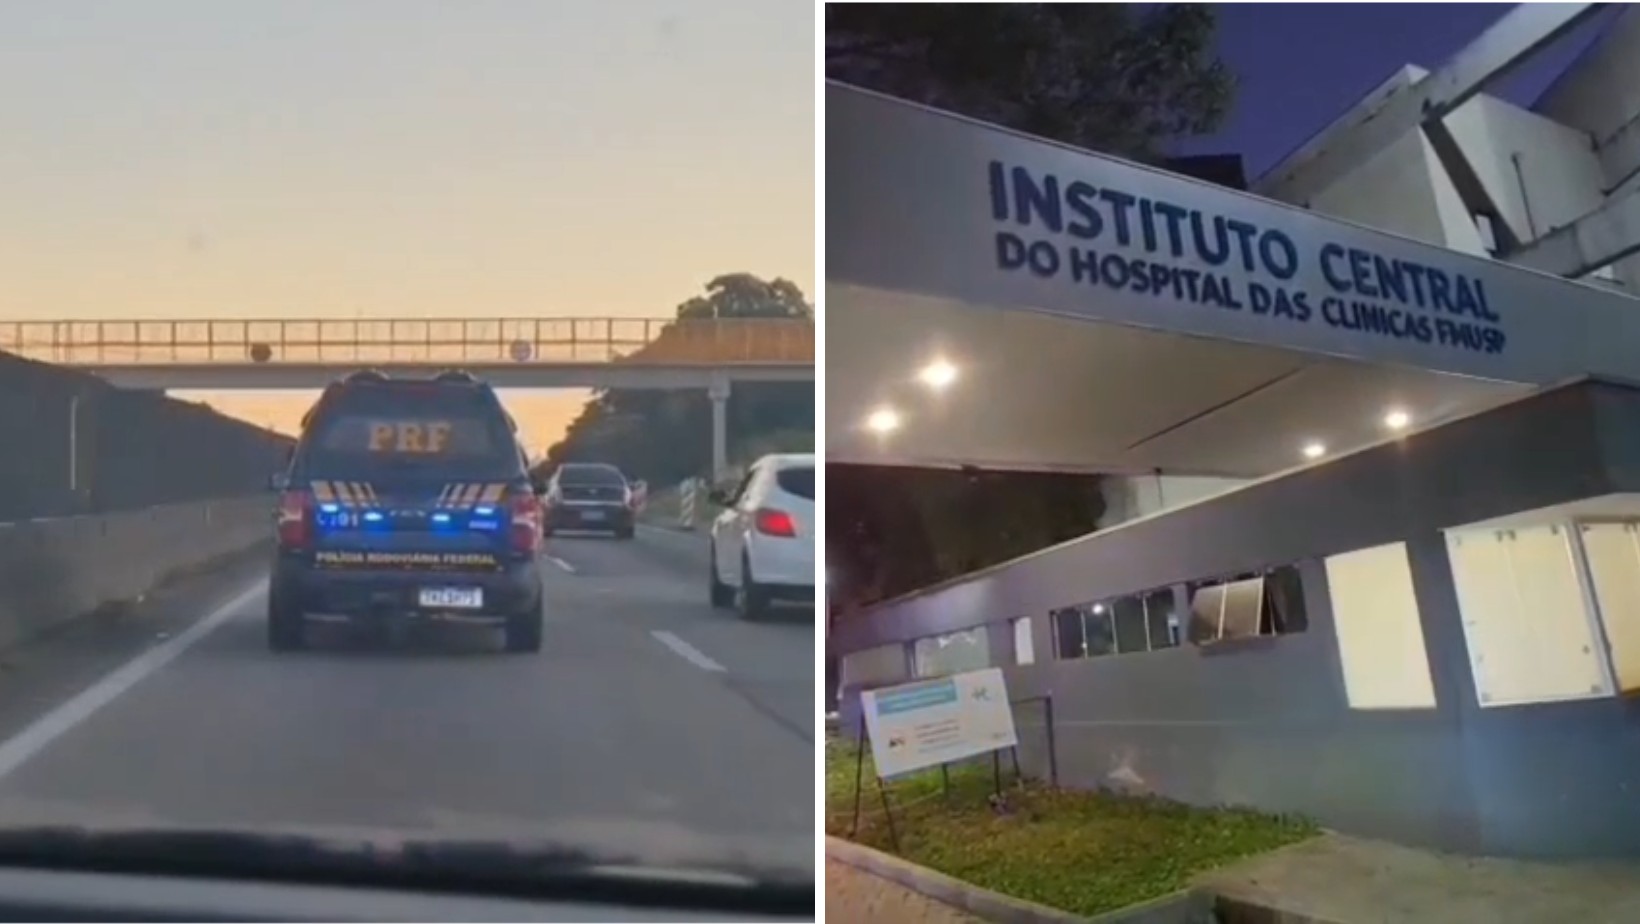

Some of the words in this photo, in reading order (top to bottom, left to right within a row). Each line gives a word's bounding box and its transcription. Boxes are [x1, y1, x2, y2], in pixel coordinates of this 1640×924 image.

[989, 160, 1298, 280] INSTITUTO
[1320, 244, 1501, 323] CENTRAL
[995, 231, 1060, 277] DO
[1071, 248, 1243, 312] HOSPITAL
[1250, 283, 1311, 323] DAS
[1435, 318, 1506, 354] FMUSP
[369, 422, 451, 451] PRF
[443, 553, 496, 565] FEDERAL
